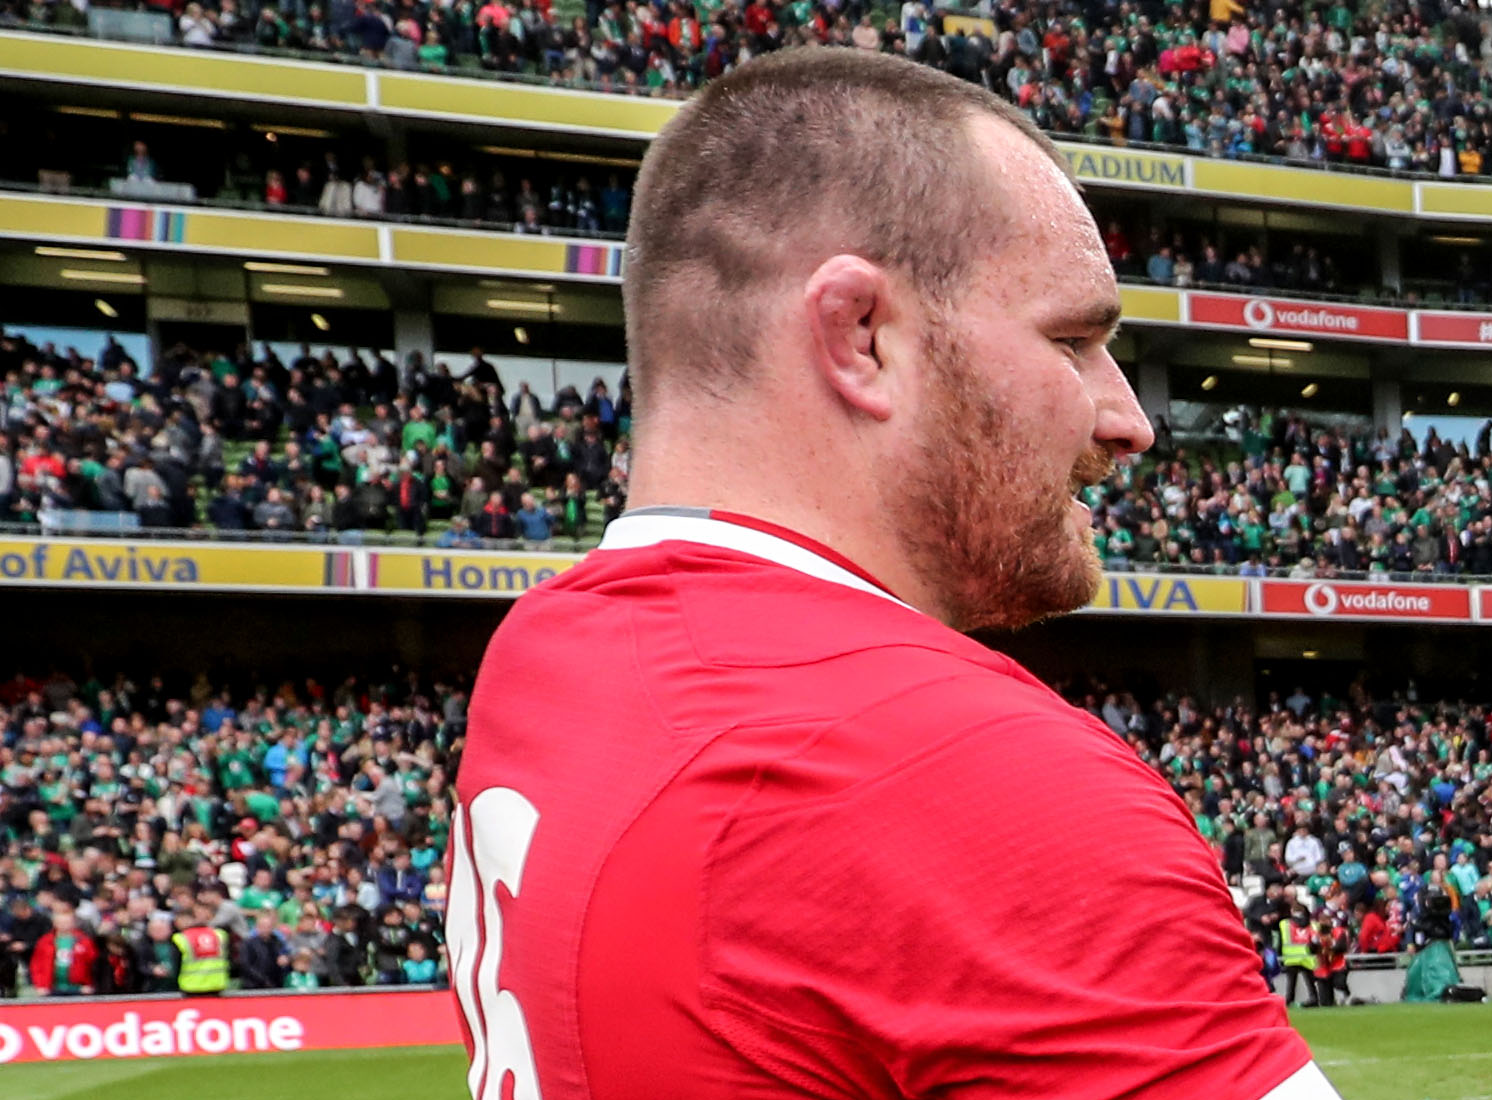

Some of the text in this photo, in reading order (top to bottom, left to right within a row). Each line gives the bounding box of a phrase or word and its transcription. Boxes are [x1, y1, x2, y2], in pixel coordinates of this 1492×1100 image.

[1063, 151, 1185, 185] TADIUM
[1276, 309, 1358, 329] vodafone
[0, 544, 198, 582] of Aviva
[1110, 578, 1199, 611] IVA
[1340, 590, 1430, 611] vodafone
[28, 1009, 305, 1059] vodafone
